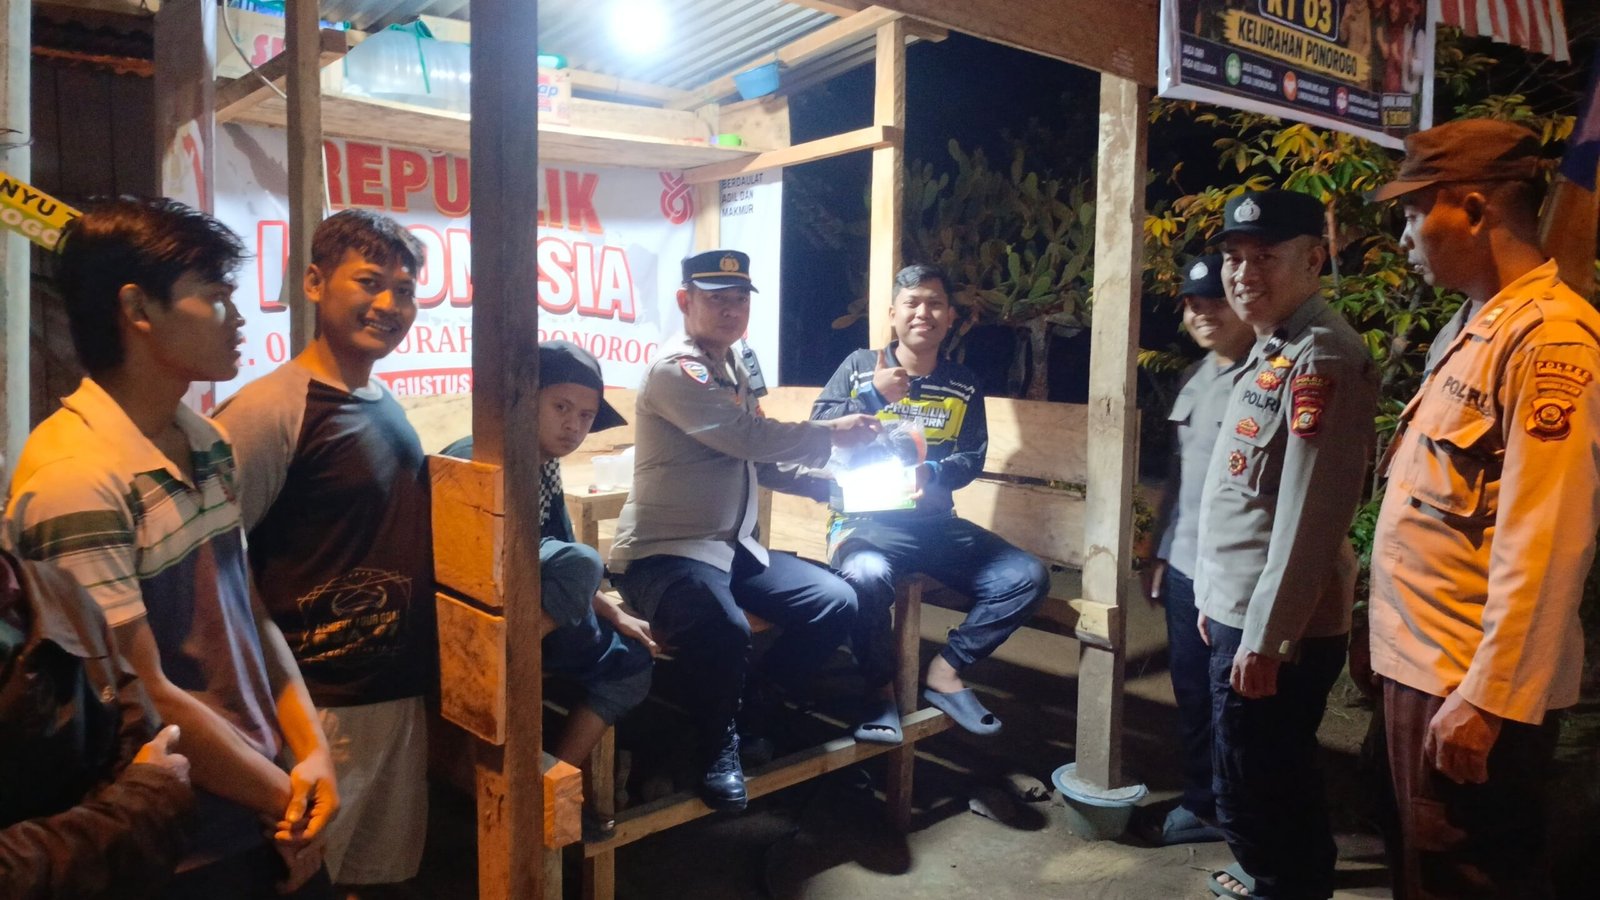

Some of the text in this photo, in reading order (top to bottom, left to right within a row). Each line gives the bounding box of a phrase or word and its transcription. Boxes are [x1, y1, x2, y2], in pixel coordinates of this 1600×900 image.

[1304, 0, 1332, 34] 03
[1237, 16, 1303, 60] KELURAHAN
[1305, 40, 1358, 78] PONOROGO
[721, 203, 754, 217] MAKMUR
[740, 190, 754, 202] DAN
[0, 203, 61, 246] OGO
[1242, 390, 1281, 413] POLRI
